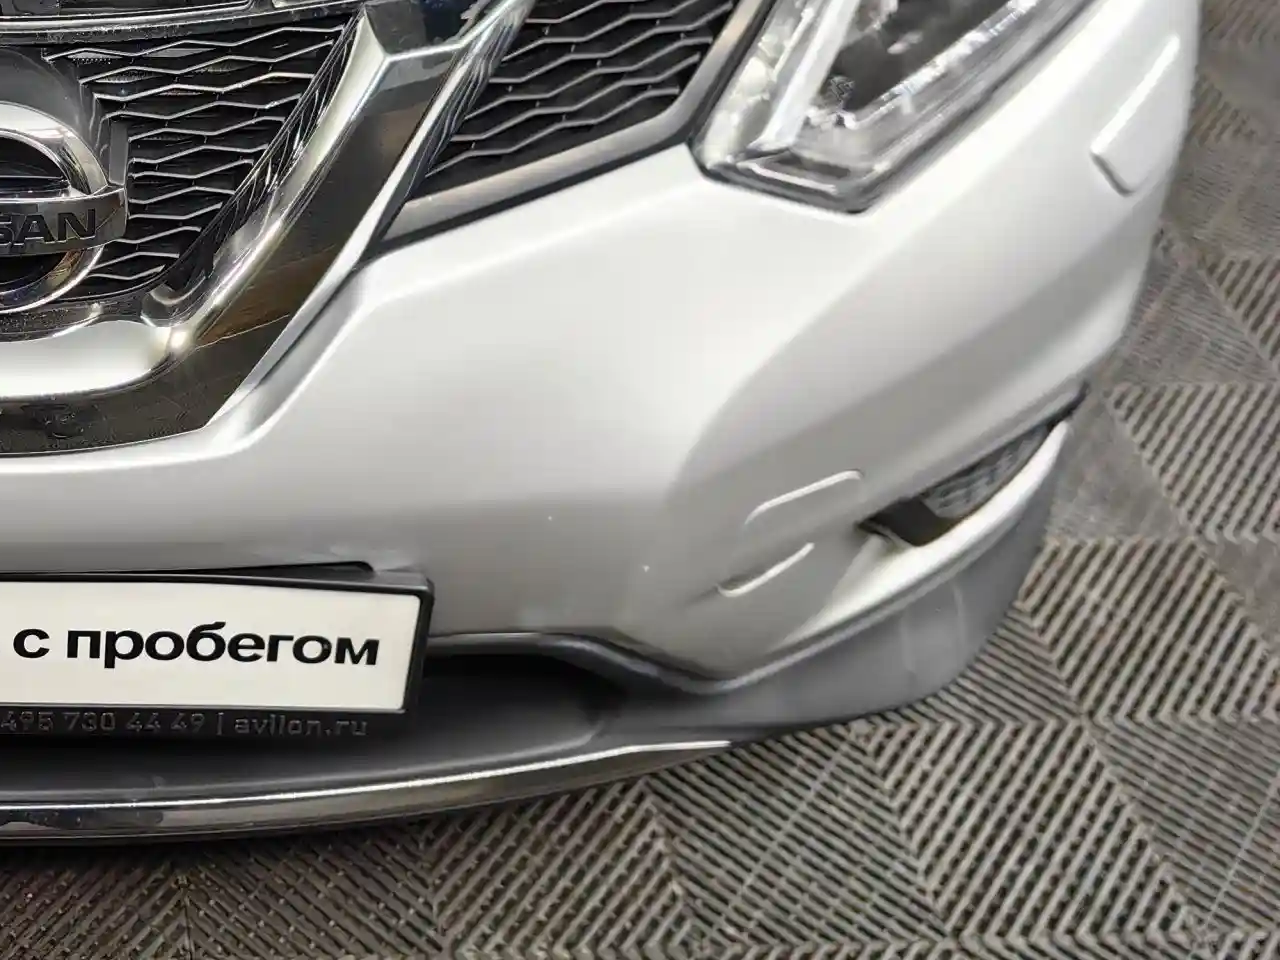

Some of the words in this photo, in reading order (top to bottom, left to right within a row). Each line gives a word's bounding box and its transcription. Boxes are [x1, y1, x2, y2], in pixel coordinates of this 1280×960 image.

[13, 628, 51, 659] с
[66, 621, 380, 669] пробегом
[0, 710, 54, 734] 495
[64, 710, 116, 733] 730
[125, 711, 162, 734] 44
[170, 712, 207, 734] 49
[234, 712, 368, 737] avilon.ru
